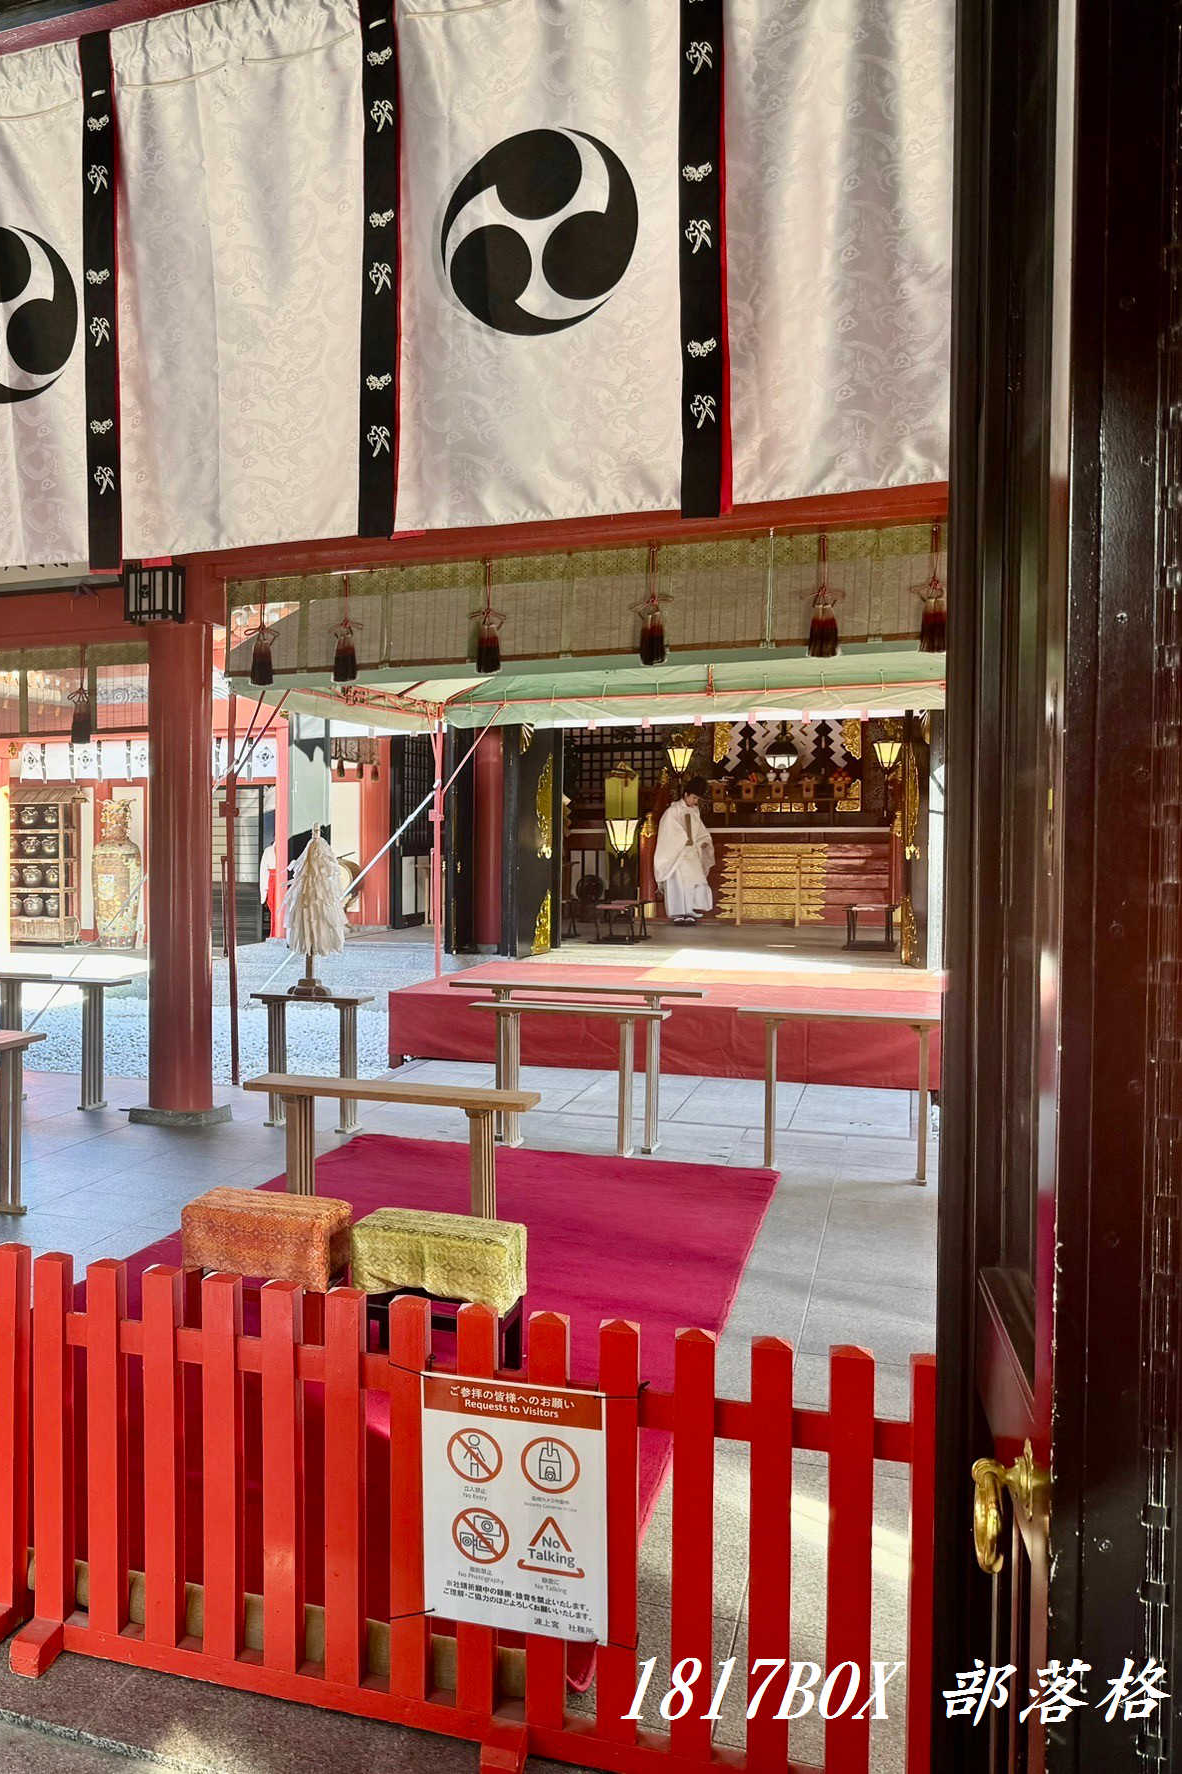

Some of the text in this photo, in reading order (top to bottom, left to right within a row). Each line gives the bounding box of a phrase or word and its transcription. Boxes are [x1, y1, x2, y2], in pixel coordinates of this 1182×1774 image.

[450, 1385, 575, 1410] ご参拝の皆様へのお願い
[465, 1399, 559, 1419] Requests to Visitors
[542, 1536, 560, 1549] No
[527, 1548, 576, 1568] Talking
